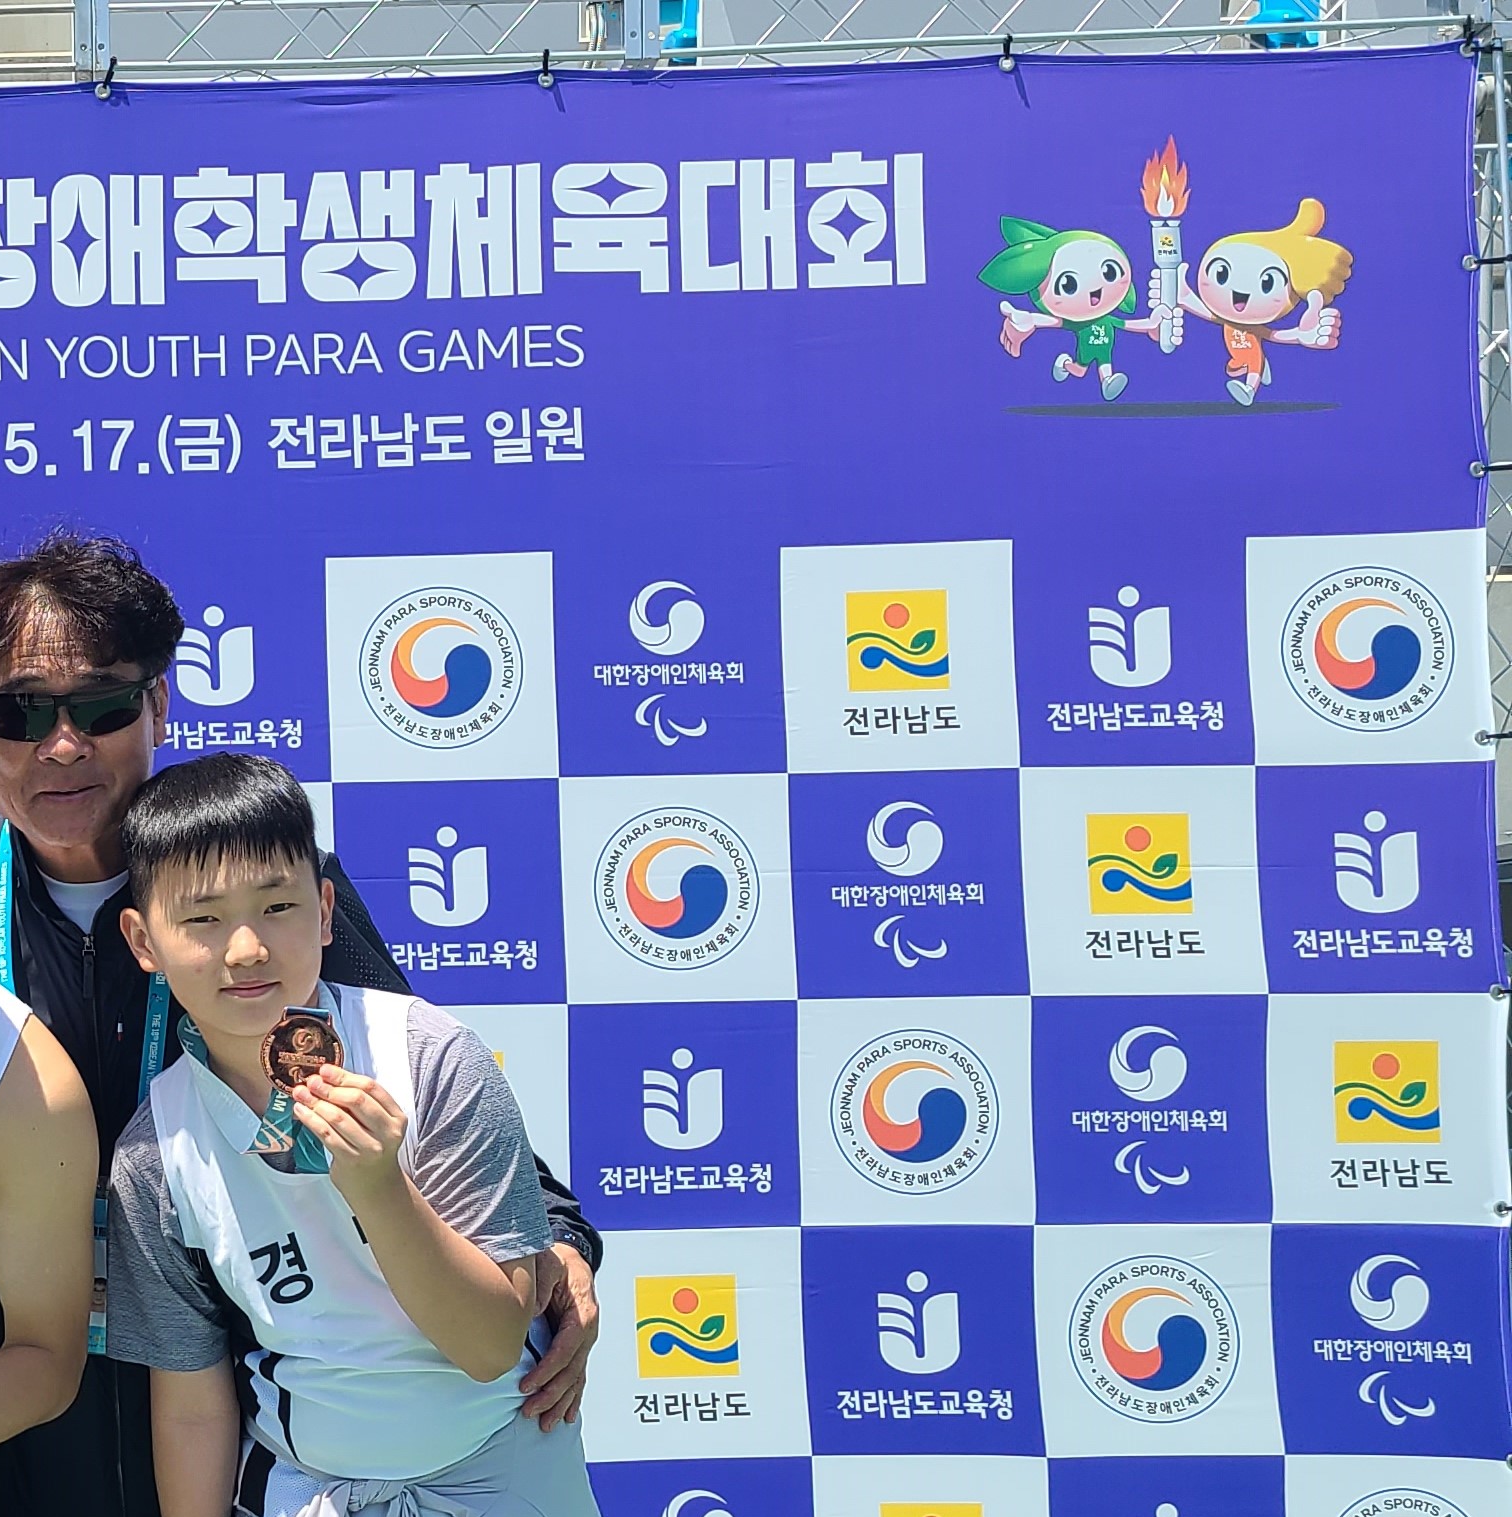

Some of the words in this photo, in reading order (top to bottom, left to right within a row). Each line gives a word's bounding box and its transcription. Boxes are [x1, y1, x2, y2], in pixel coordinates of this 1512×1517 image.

[45, 336, 225, 378] YOUTH
[247, 333, 383, 375] PARA
[399, 325, 584, 372] GAMES
[268, 413, 471, 468] 전라남도
[486, 407, 584, 463] 일원
[1291, 611, 1311, 674] JEONNAM
[1307, 584, 1342, 610] PARA
[1345, 576, 1400, 591] SPORTS
[1402, 589, 1444, 670] ASSOCIATION
[369, 630, 388, 692] JEONNAM
[384, 604, 417, 629] PARA
[420, 596, 472, 611] SPORTS
[473, 609, 513, 688] ASSOCIATION
[594, 662, 743, 685] 대한장애인체육회
[1048, 702, 1223, 731] 전라남도교육청
[1308, 684, 1433, 723] 전라남도장애인체육회
[164, 719, 303, 750] 라남도교육청
[383, 702, 502, 740] 전라남도장애인체육회
[844, 706, 960, 735] 전라남도
[604, 850, 623, 912] JEONNAM
[619, 824, 651, 850] PARA
[654, 816, 707, 832] SPORTS
[709, 829, 750, 910] ASSOCIATION
[832, 883, 983, 907] 대한장애인체육회
[385, 940, 538, 971] 라남도교육청
[619, 923, 739, 961] 전라남도장애인체육회
[1086, 930, 1204, 958] 전라남도
[1294, 928, 1472, 957] 전라남도교육청
[840, 1073, 860, 1136] JEONNAM
[857, 1046, 891, 1072] PARA
[894, 1039, 948, 1055] SPORTS
[949, 1052, 989, 1134] ASSOCIATION
[1073, 1110, 1227, 1132] 대한장애인체육회
[599, 1164, 771, 1195] 전라남도교육청
[855, 1147, 977, 1186] 전라남도장애인체육회
[1331, 1159, 1452, 1187] 전라남도
[249, 1232, 314, 1304] 경
[1079, 1299, 1098, 1363] JEONNAM
[1094, 1272, 1128, 1299] PARA
[1131, 1265, 1186, 1281] SPORTS
[1187, 1279, 1230, 1362] ASSOCIATION
[1314, 1339, 1471, 1364] 대한장애인체육회
[634, 1393, 750, 1423] 전라남도
[838, 1390, 1012, 1419] 전라남도교육청
[1095, 1375, 1219, 1414] 전라남도장애인체육회
[1384, 1498, 1440, 1516] SPORTS
